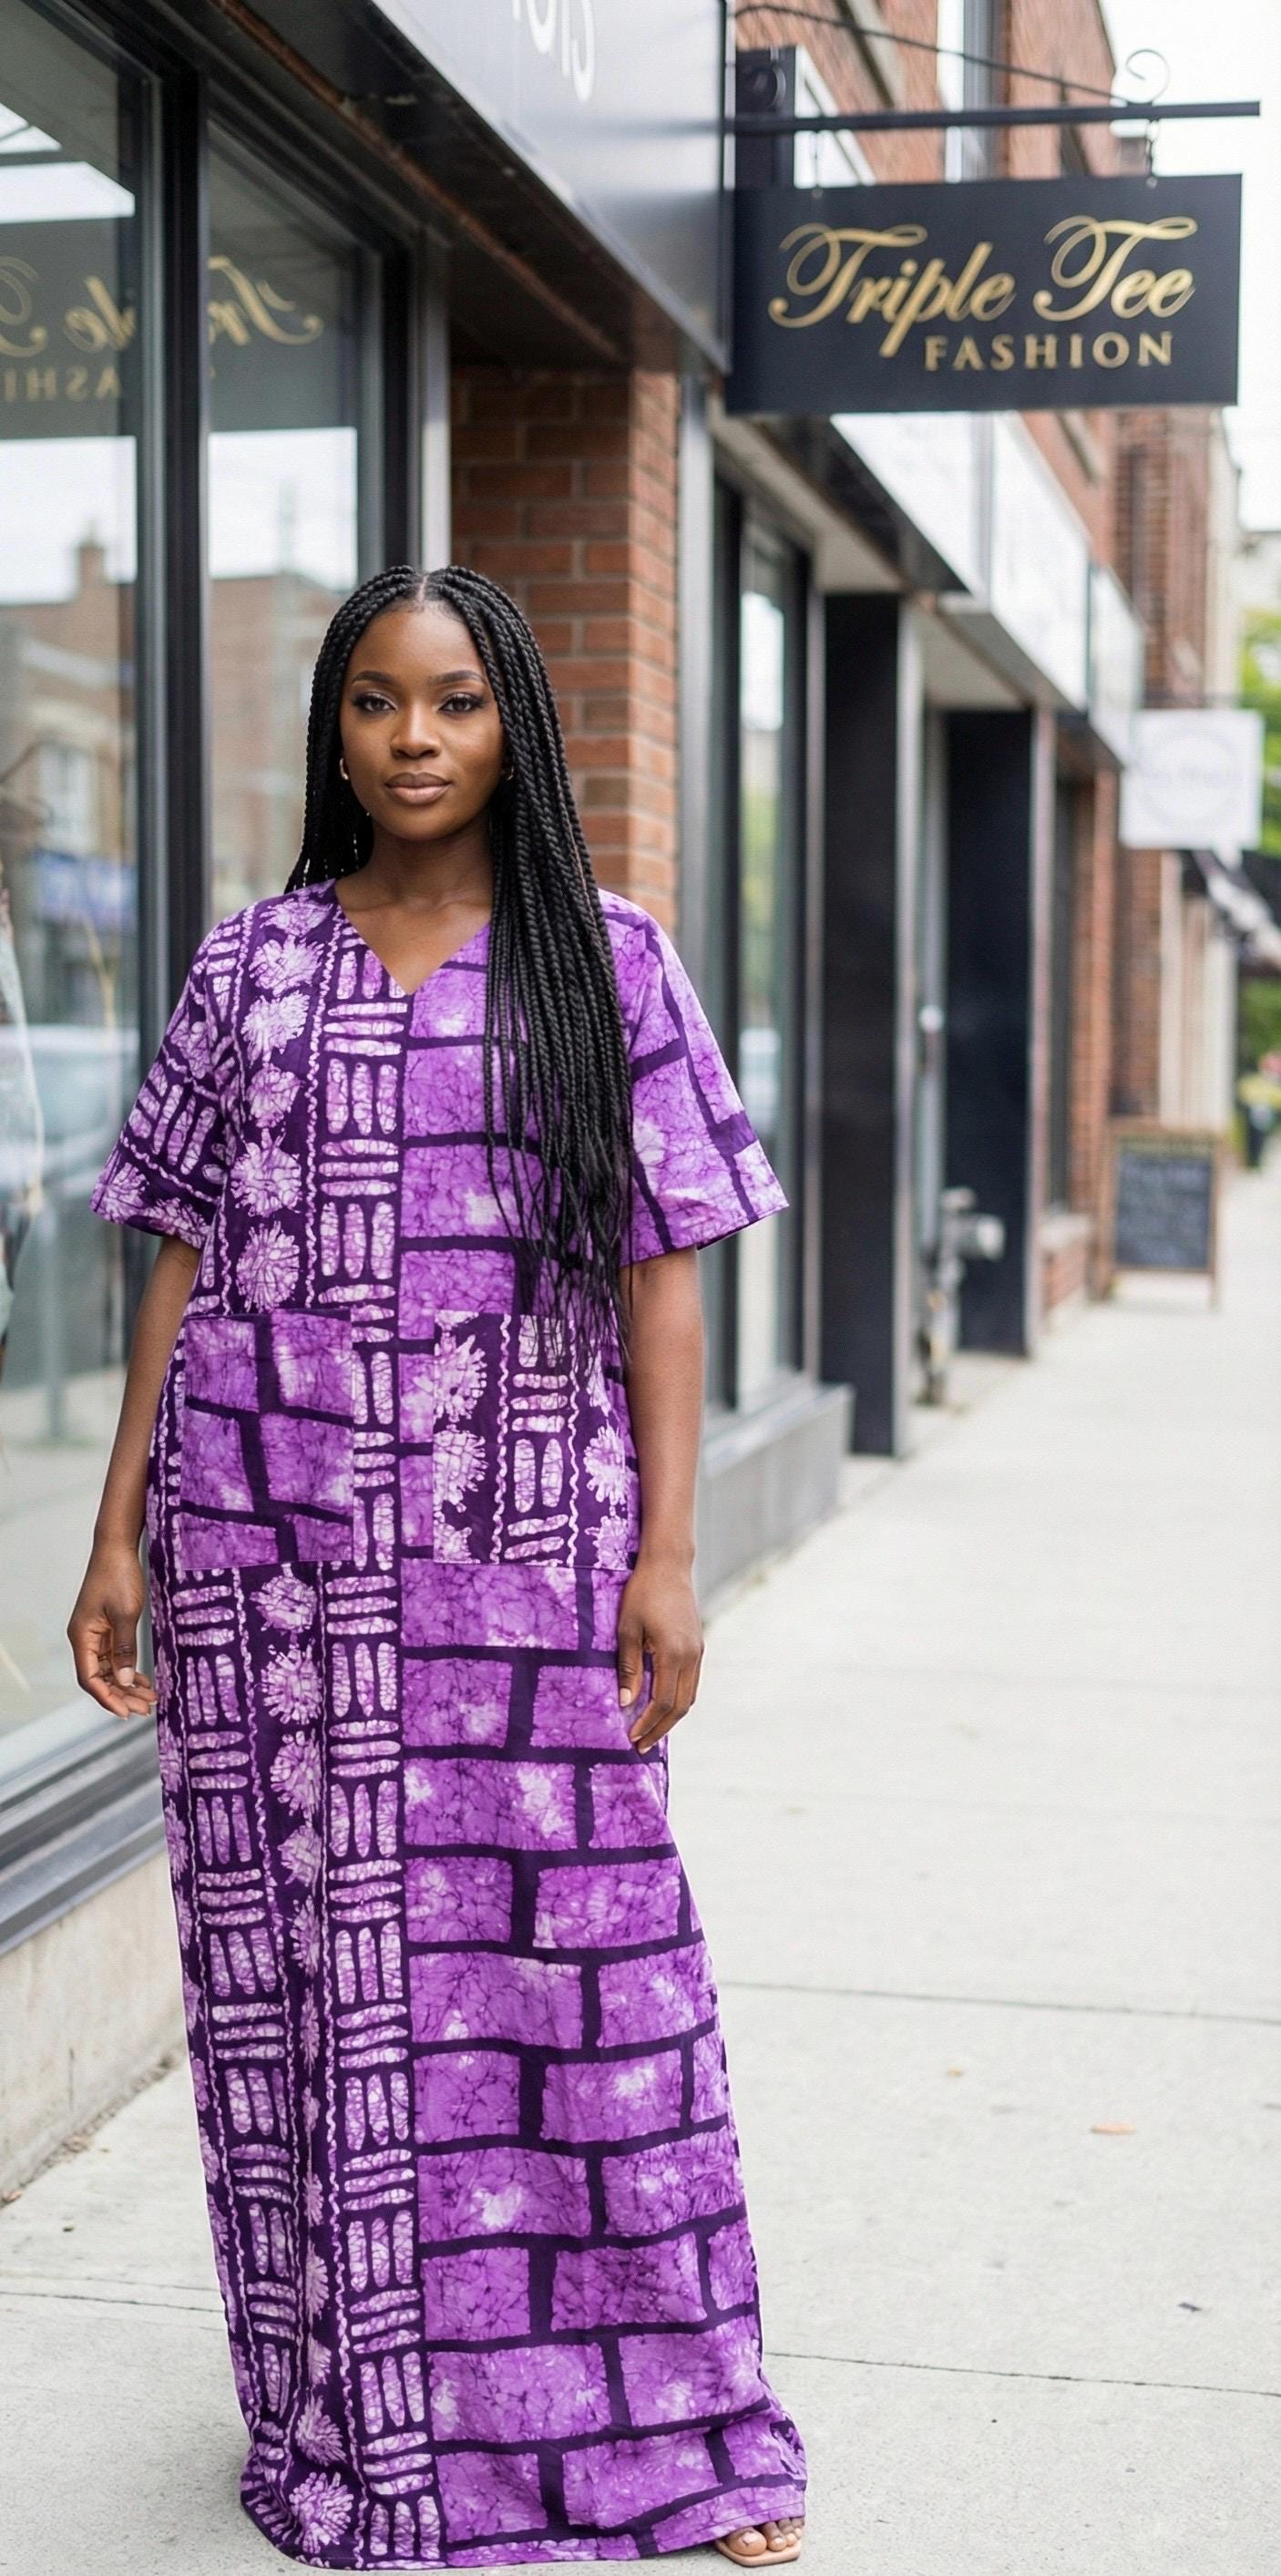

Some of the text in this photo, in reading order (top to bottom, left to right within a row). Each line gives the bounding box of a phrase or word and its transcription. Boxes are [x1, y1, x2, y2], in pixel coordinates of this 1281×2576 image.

[769, 216, 1196, 357] Triple Tee
[925, 332, 1172, 371] FASHION
